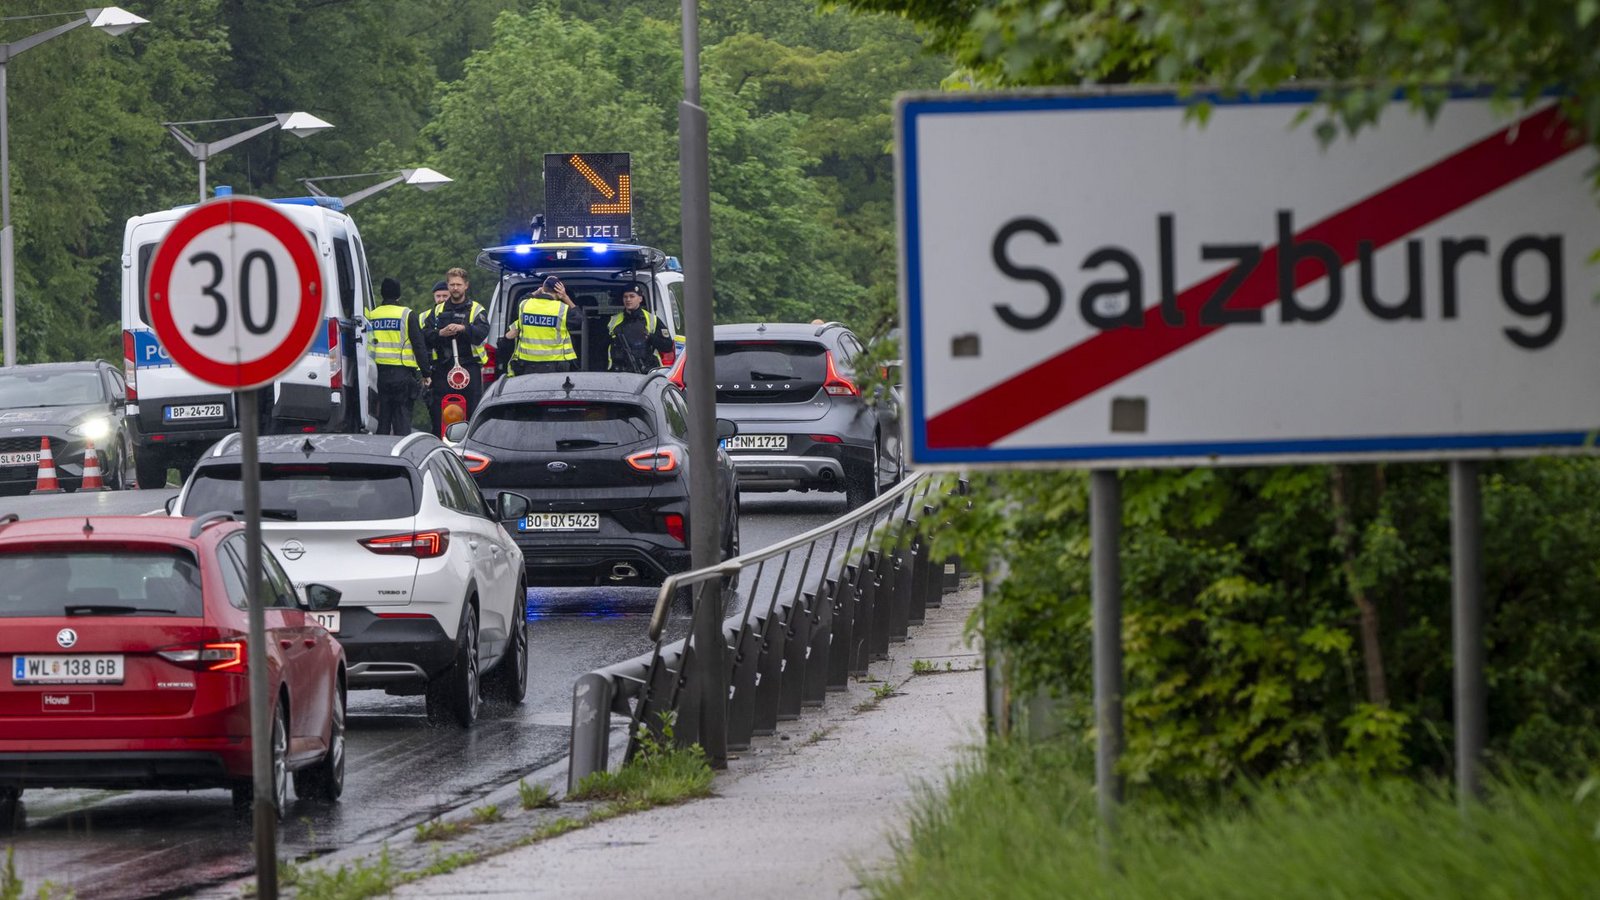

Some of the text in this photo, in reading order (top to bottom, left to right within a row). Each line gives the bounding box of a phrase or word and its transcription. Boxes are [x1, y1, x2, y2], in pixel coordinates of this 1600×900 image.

[557, 225, 620, 238] POLIZEI
[990, 209, 1565, 351] Salzburg
[188, 249, 278, 337] 30
[524, 314, 555, 326] POLIZEI
[173, 405, 221, 417] BP 24-728
[1, 455, 10, 464] SL
[16, 453, 31, 463] 249
[527, 515, 542, 527] BO
[550, 515, 565, 527] QX
[568, 514, 597, 527] 5423
[28, 659, 116, 675] WL 138 GB
[44, 695, 70, 705] Hoval
